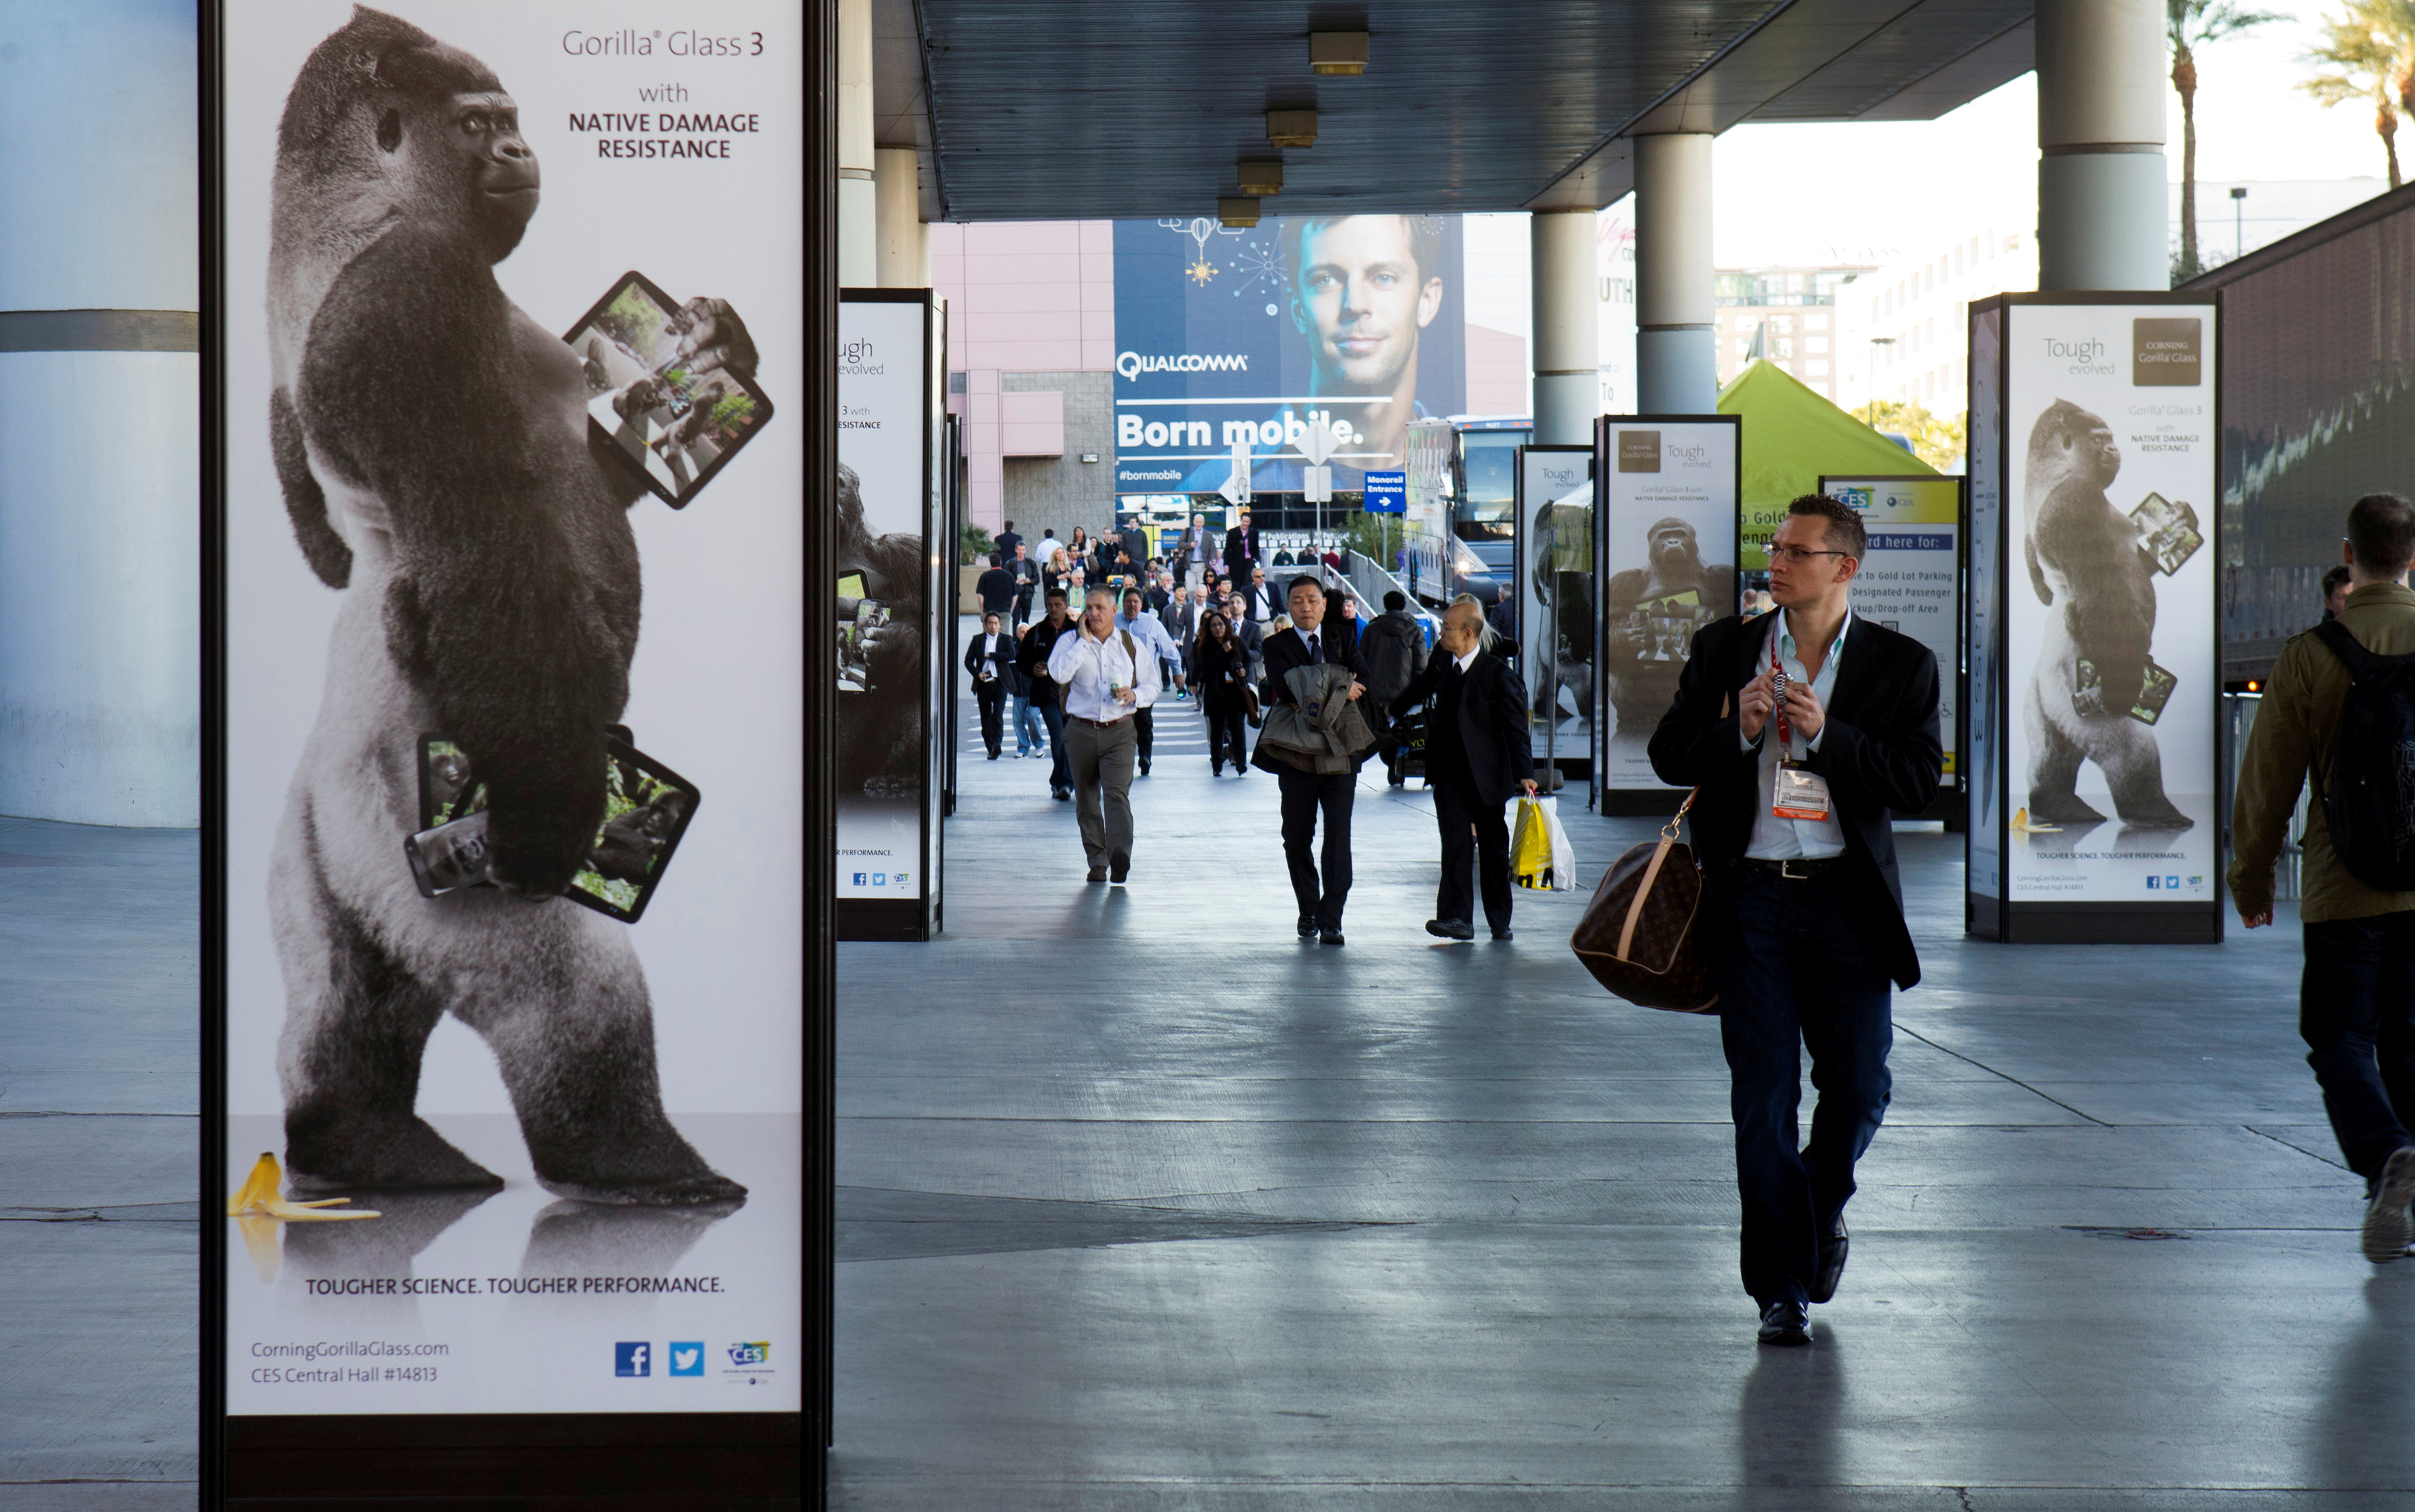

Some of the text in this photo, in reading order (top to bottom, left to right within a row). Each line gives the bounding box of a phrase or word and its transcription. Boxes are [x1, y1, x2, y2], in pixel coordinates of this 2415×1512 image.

[668, 30, 742, 56] Glass
[751, 32, 763, 56] 3
[639, 82, 688, 102] with
[569, 113, 759, 132] NATIVE DAMAGE
[599, 140, 730, 158] RESISTANCE
[2042, 337, 2104, 363] Tough
[2146, 341, 2188, 350] CORNING
[2171, 352, 2196, 362] Glass
[838, 363, 884, 375] evolved
[2069, 363, 2115, 374] evolved
[842, 406, 870, 415] 3 with
[2167, 406, 2194, 415] Glass
[2197, 406, 2201, 415] 3
[1118, 415, 1212, 447] Born
[1667, 445, 1704, 461] Tough
[1119, 470, 1182, 480] #bornmobile
[1542, 468, 1574, 482] Tough
[1885, 535, 1913, 548] here
[1918, 536, 1940, 548] for:
[1919, 572, 1952, 582] Parking
[1852, 588, 1951, 598] Designated Passenger
[306, 1277, 725, 1295] TOUGHER SCIENCE. TOUGHER PERFORMANCE.
[251, 1341, 449, 1361] CorningGorillaGlass.com
[732, 1347, 762, 1362] CES
[251, 1366, 437, 1382] CES Central Hall #14813
